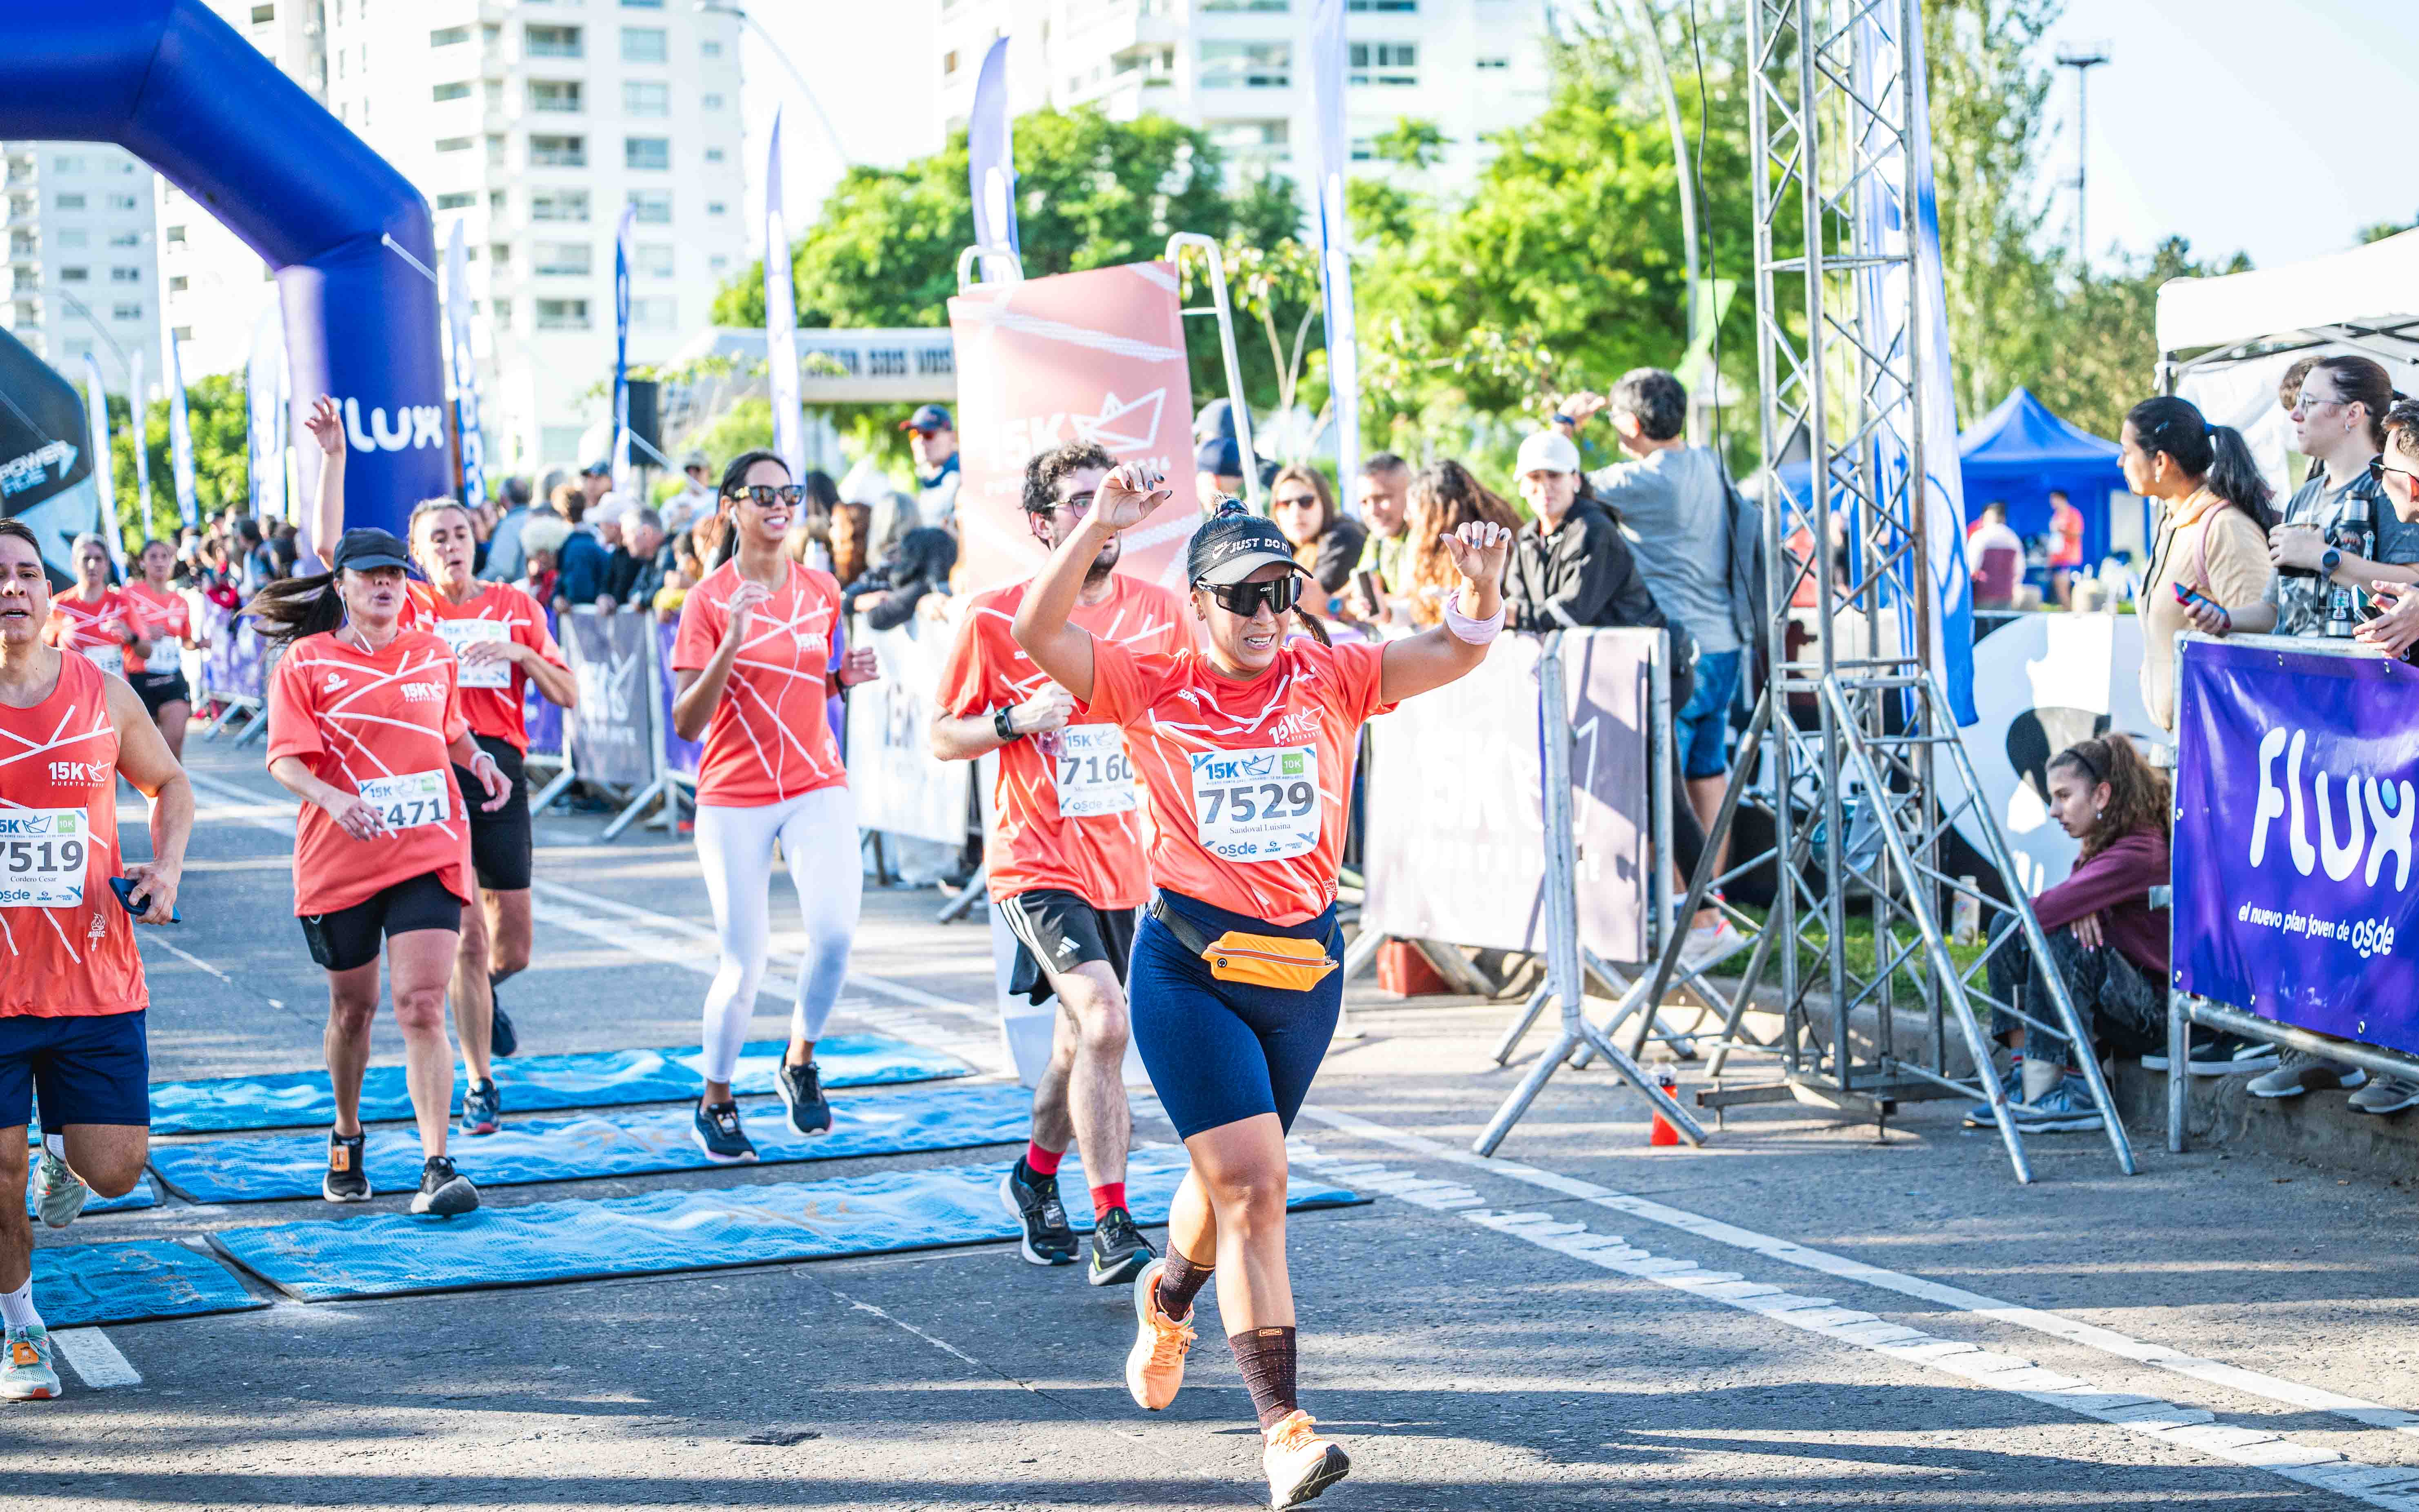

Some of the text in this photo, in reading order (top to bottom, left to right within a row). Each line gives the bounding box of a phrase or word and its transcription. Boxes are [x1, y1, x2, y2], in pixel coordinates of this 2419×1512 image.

[1229, 538, 1260, 554] JUST
[1265, 538, 1281, 549] DO
[1268, 714, 1300, 745] 15K
[1067, 734, 1093, 747] 15K
[48, 762, 85, 780] 15K
[1206, 759, 1302, 780] 15K 10K
[369, 786, 392, 798] 15K
[1073, 799, 1103, 812] osde
[1198, 782, 1314, 824] 7529
[374, 798, 445, 826] 471
[1229, 823, 1291, 835] Sandoval Luisina
[1218, 841, 1257, 857] osde
[2238, 901, 2395, 958] el nuevo plan joven de osde
